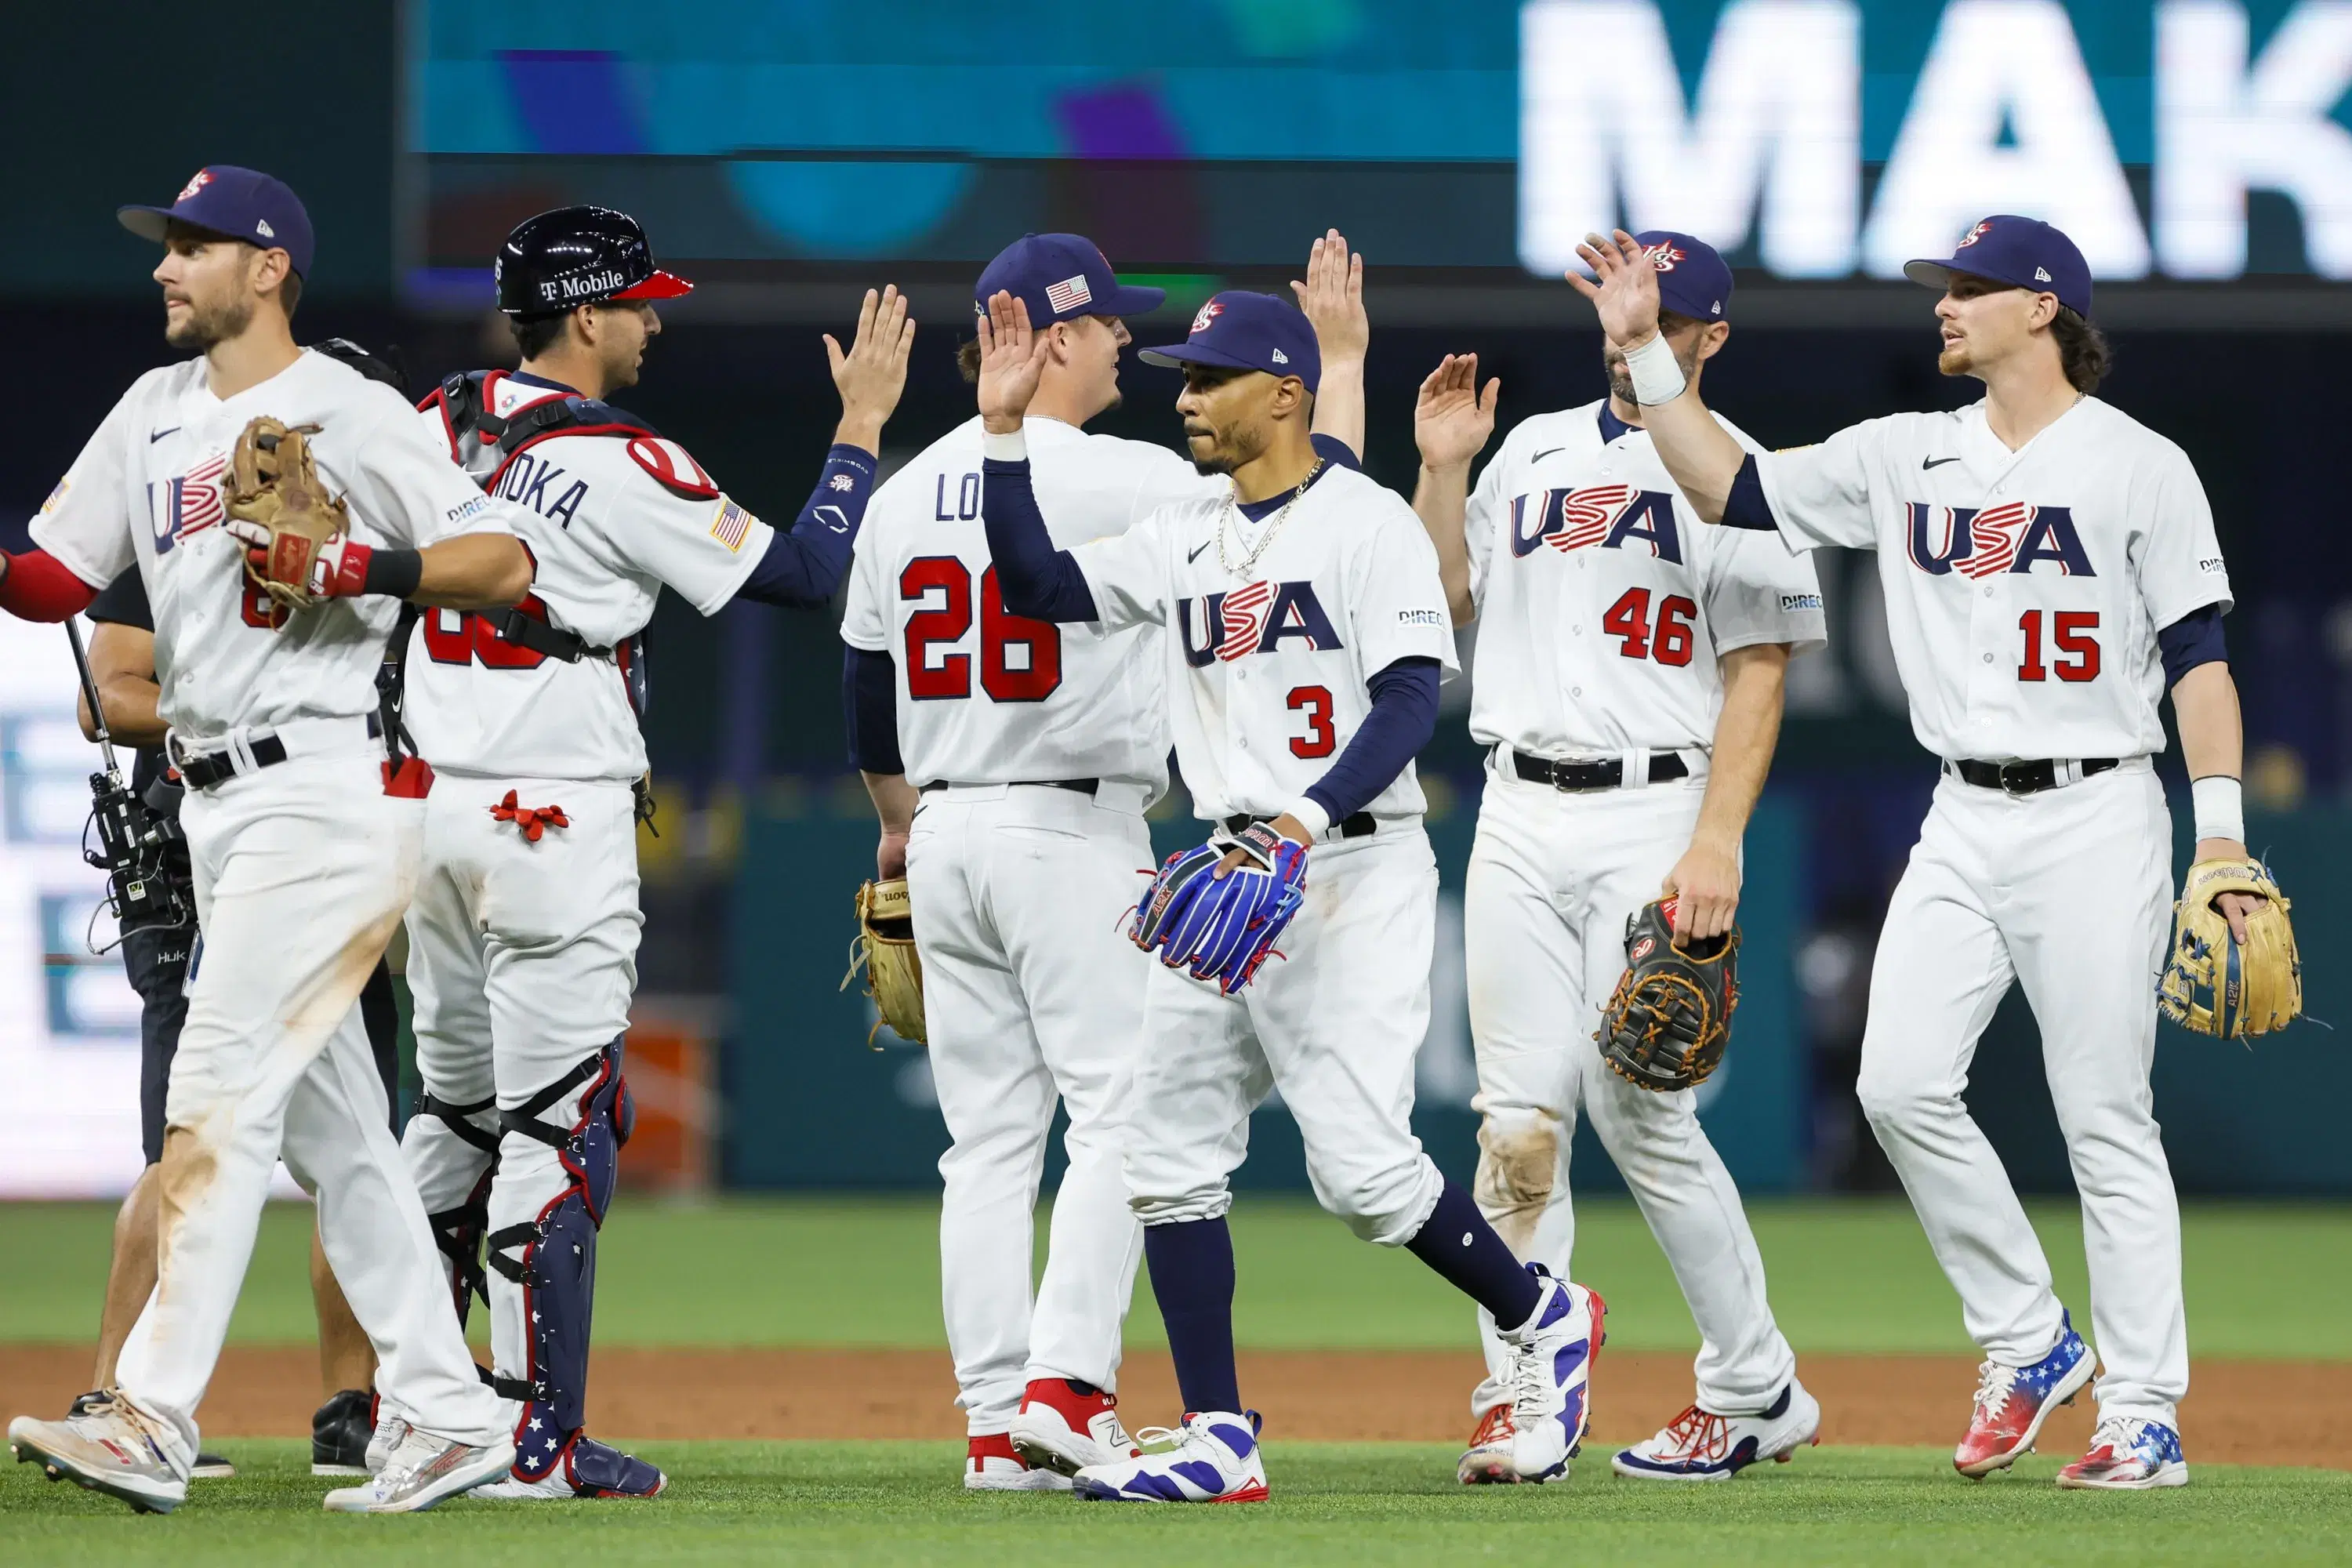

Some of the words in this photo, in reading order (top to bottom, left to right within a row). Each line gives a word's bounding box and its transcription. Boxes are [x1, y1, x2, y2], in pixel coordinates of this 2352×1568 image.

[560, 270, 624, 298] Mobile
[935, 473, 981, 521] LO
[1510, 484, 1684, 566] USA
[1905, 501, 2097, 580] USA
[899, 555, 1062, 703] 26
[1176, 579, 1345, 669] USA
[1603, 586, 1697, 667] 46
[2017, 609, 2101, 683] 15
[1287, 684, 1337, 760] 3
[884, 891, 911, 903] son
[1152, 884, 1174, 919] A2K
[2198, 866, 2251, 886] Wilson
[2227, 979, 2240, 1008] A2K
